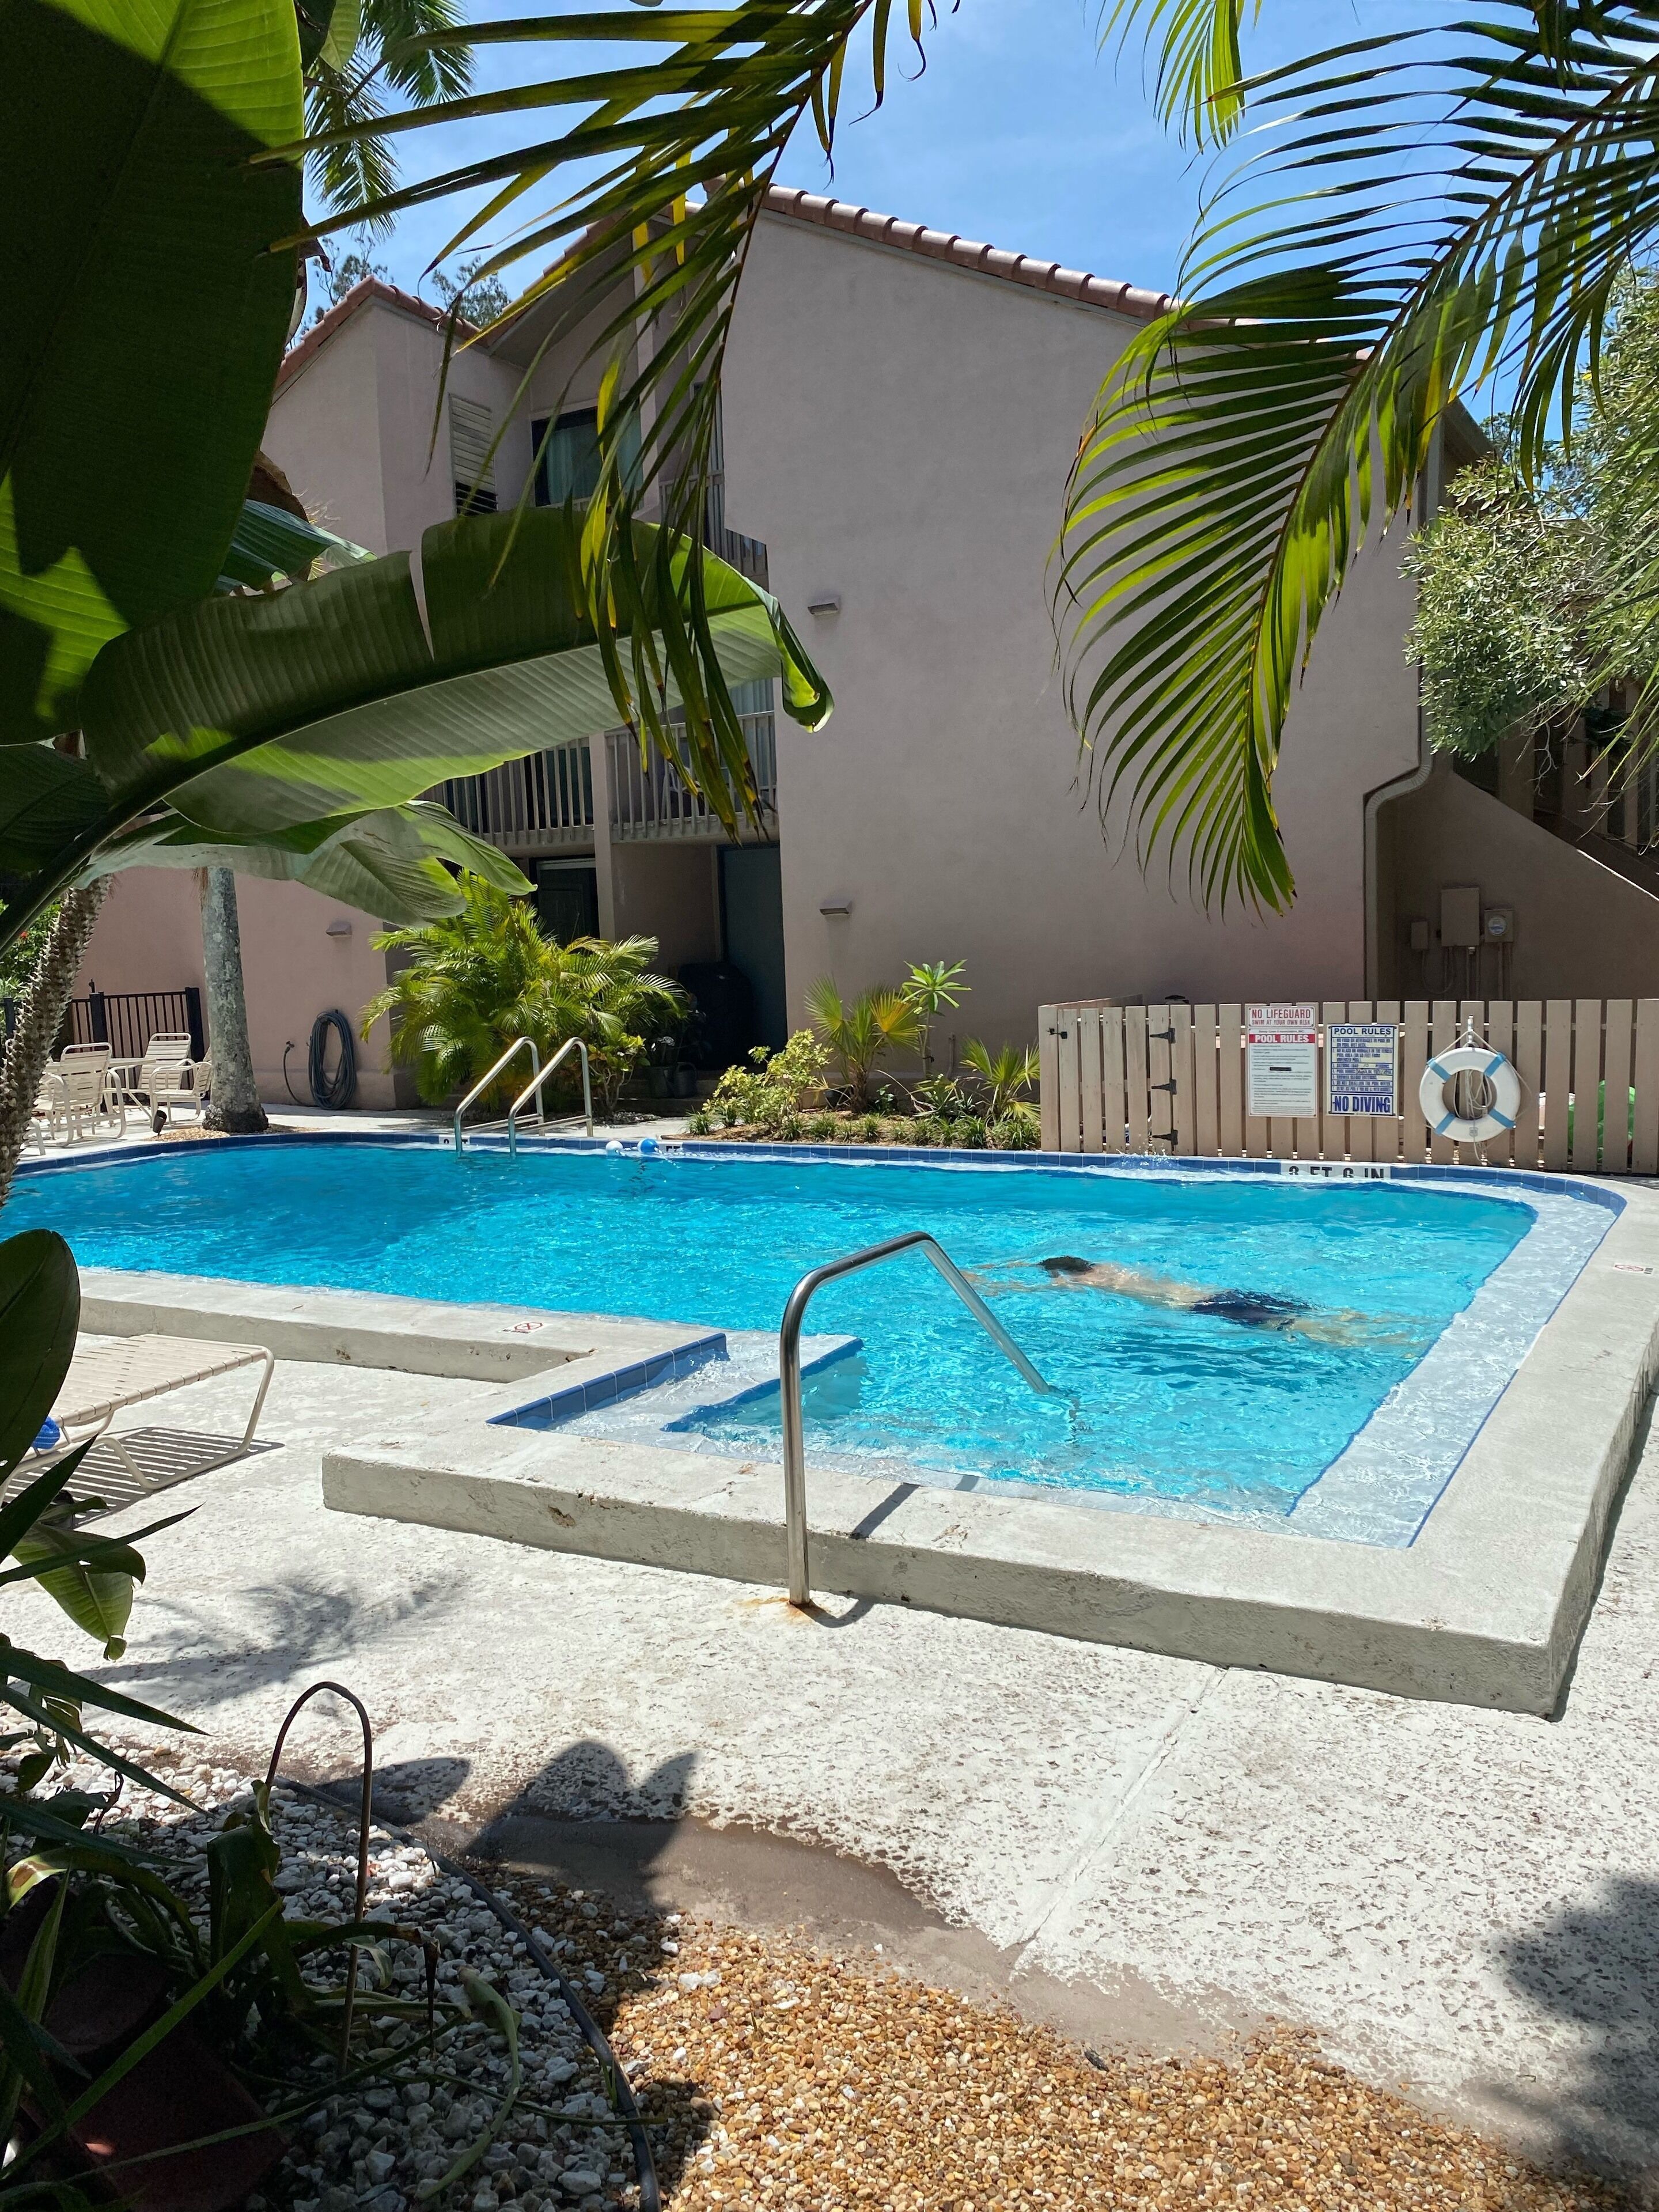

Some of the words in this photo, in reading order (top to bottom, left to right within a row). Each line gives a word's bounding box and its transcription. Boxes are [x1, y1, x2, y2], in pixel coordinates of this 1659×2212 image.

[1252, 1009, 1262, 1018] NO
[1266, 1009, 1310, 1018] LIFEGUARD
[1255, 1035, 1278, 1043] POOL
[1280, 1035, 1309, 1043] RULES
[1334, 1096, 1349, 1112] NO
[1352, 1096, 1391, 1113] DIVING
[1365, 1168, 1384, 1179] IN
